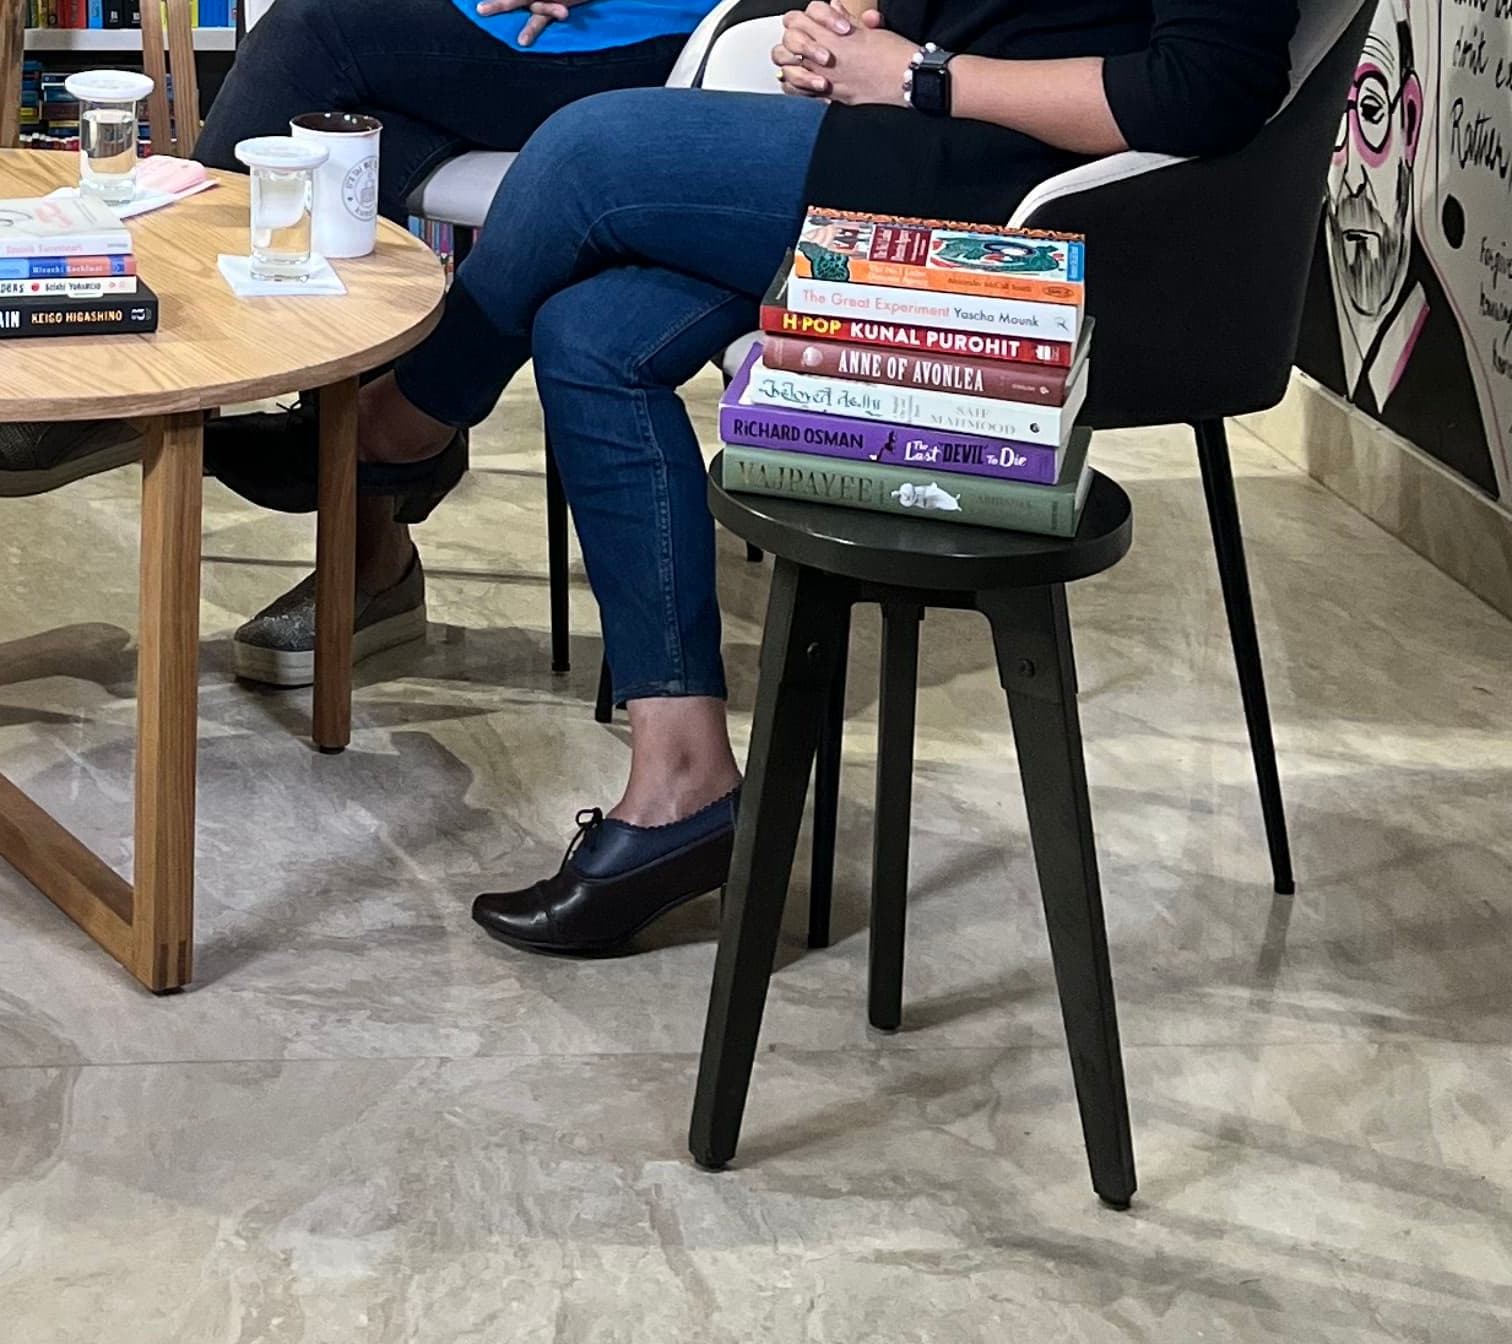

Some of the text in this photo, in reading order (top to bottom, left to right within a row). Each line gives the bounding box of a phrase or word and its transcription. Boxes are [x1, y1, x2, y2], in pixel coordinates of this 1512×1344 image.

[32, 312, 62, 326] KEIGO
[65, 309, 123, 324] HIGASHINO
[803, 289, 1039, 328] The Great Experiment Yascha Mounk
[850, 323, 920, 346] KUNAL
[926, 330, 1020, 358] PUROHIT
[838, 350, 985, 392] ANNE OF AVONLEA
[930, 411, 1016, 436] MAHMOOD
[804, 427, 864, 450] OSMAN
[912, 439, 929, 453] The
[903, 440, 938, 463] Last
[941, 442, 986, 467] DEVIL
[998, 447, 1028, 469] Die
[737, 460, 875, 504] VAJPAYEE
